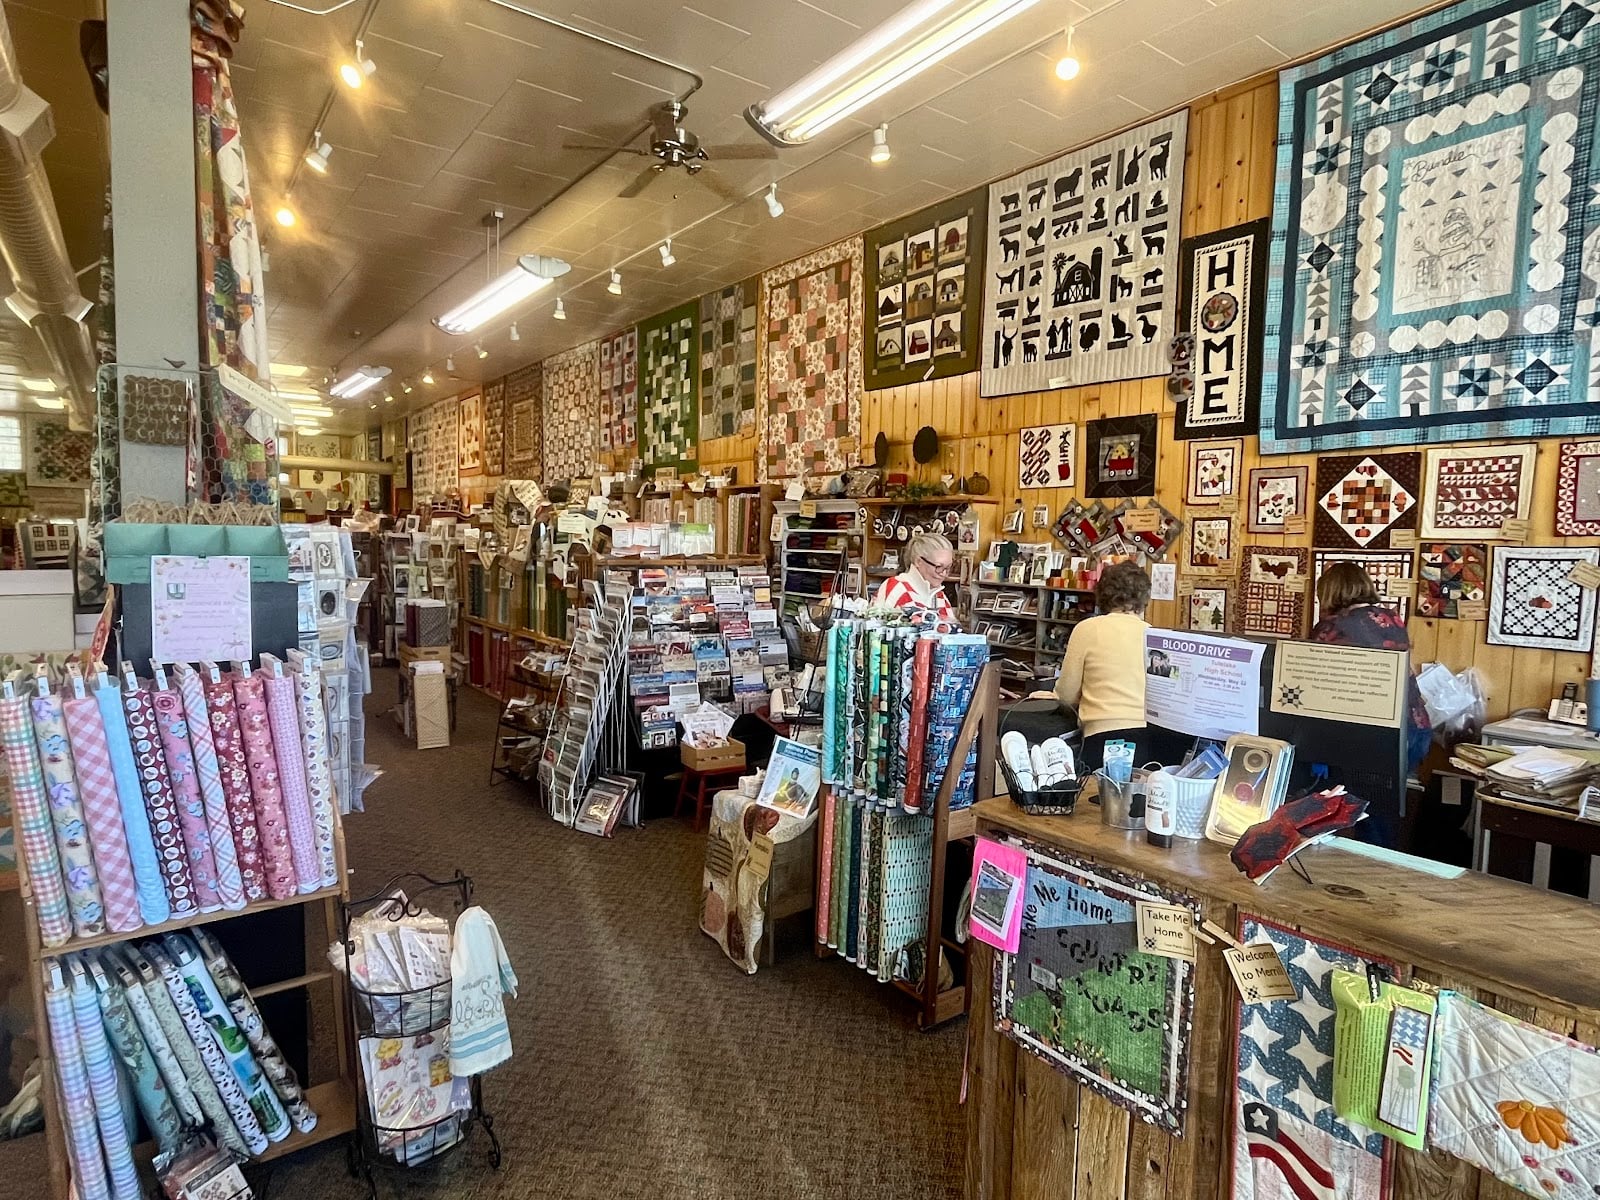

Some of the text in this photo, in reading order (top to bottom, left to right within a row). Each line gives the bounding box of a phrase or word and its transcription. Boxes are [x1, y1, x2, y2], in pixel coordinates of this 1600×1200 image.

[1162, 639, 1232, 658] BLOOD DRIVE
[1205, 667, 1243, 678] High School
[1229, 678, 1238, 686] May
[1033, 880, 1060, 906] Me
[1067, 886, 1113, 924] Home
[1147, 910, 1188, 924] Take Me
[1154, 927, 1183, 939] Home
[1234, 950, 1276, 963] Welcome
[1242, 968, 1284, 980] to Merrill
